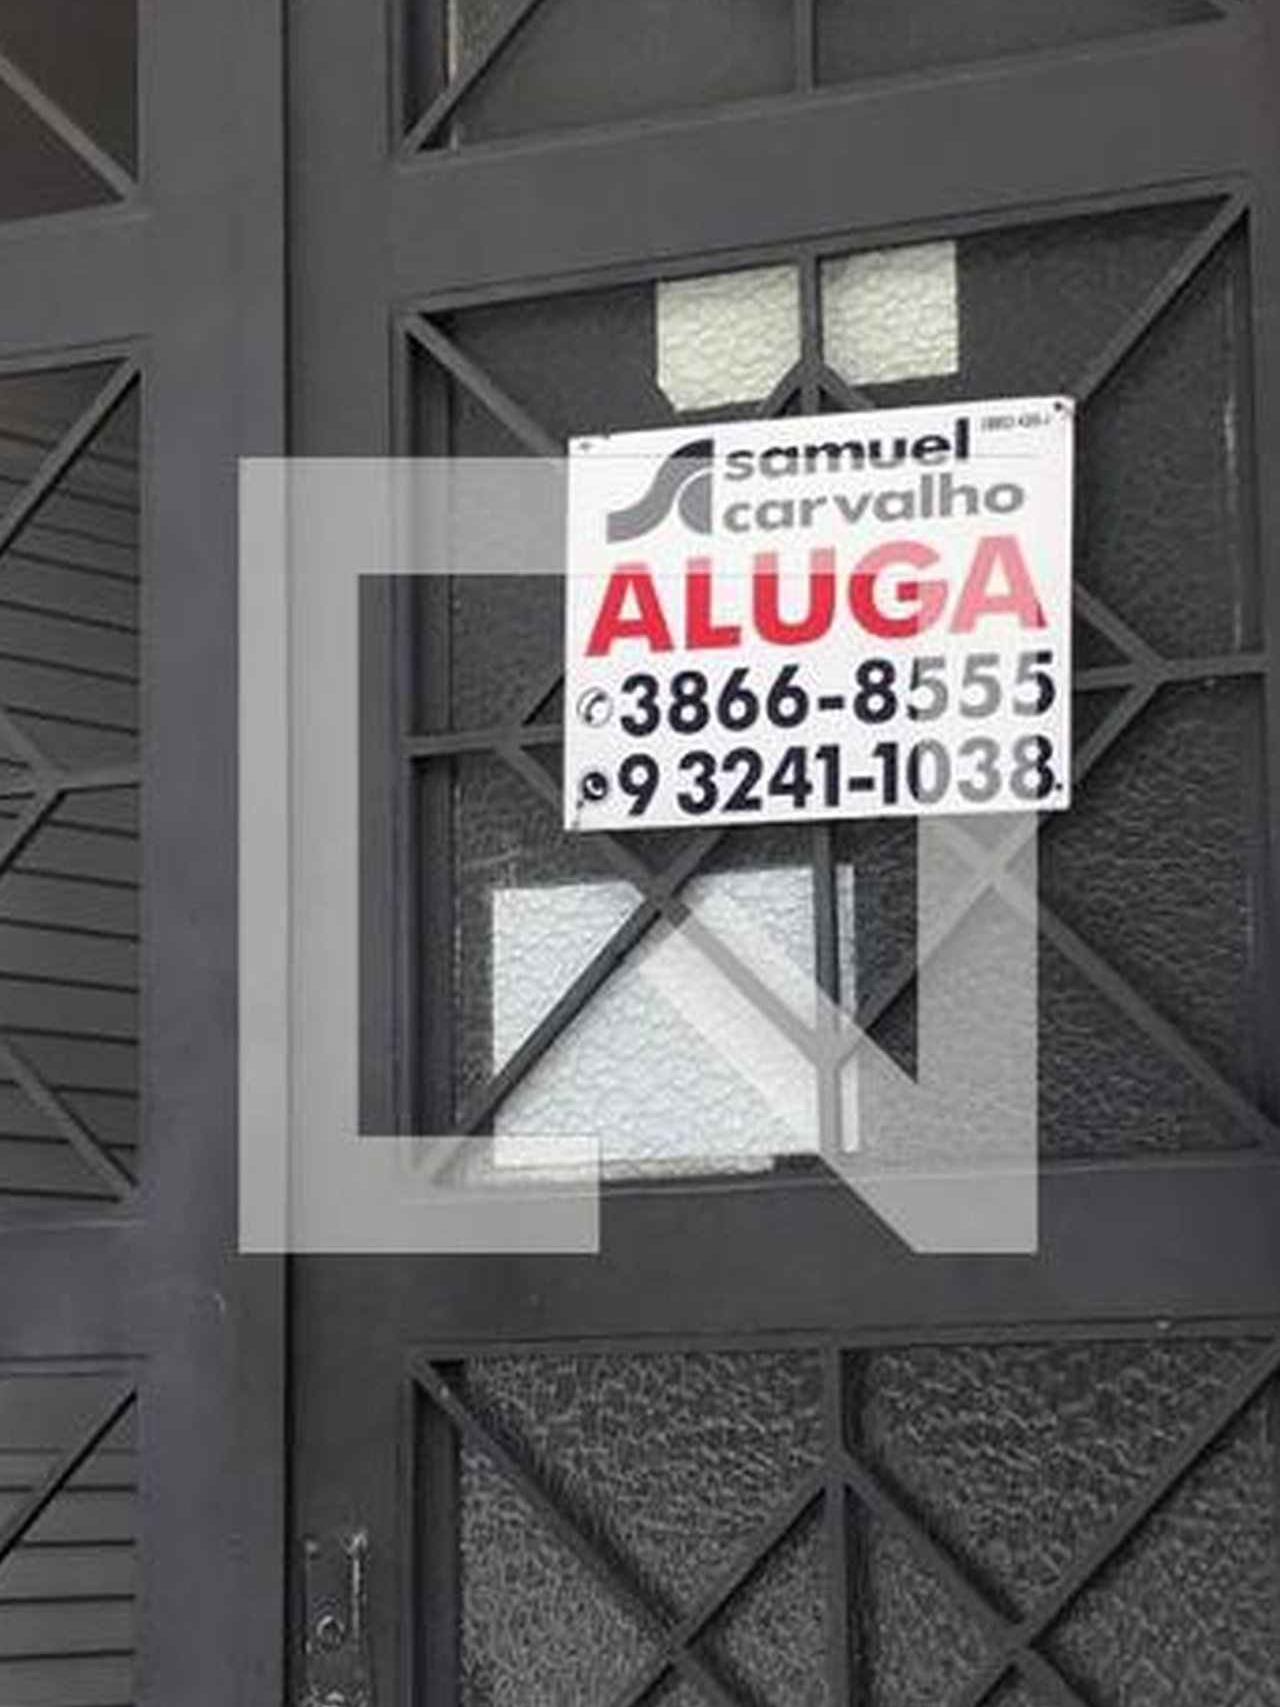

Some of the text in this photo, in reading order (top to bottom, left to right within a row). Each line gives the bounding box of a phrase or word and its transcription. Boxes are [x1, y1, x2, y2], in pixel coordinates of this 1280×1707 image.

[724, 418, 971, 480] samuel
[723, 473, 1026, 534] carvalho
[584, 534, 1048, 657] ALUGA
[619, 651, 1057, 737] 3866-8555
[618, 734, 1057, 817] 9 3241-1038
